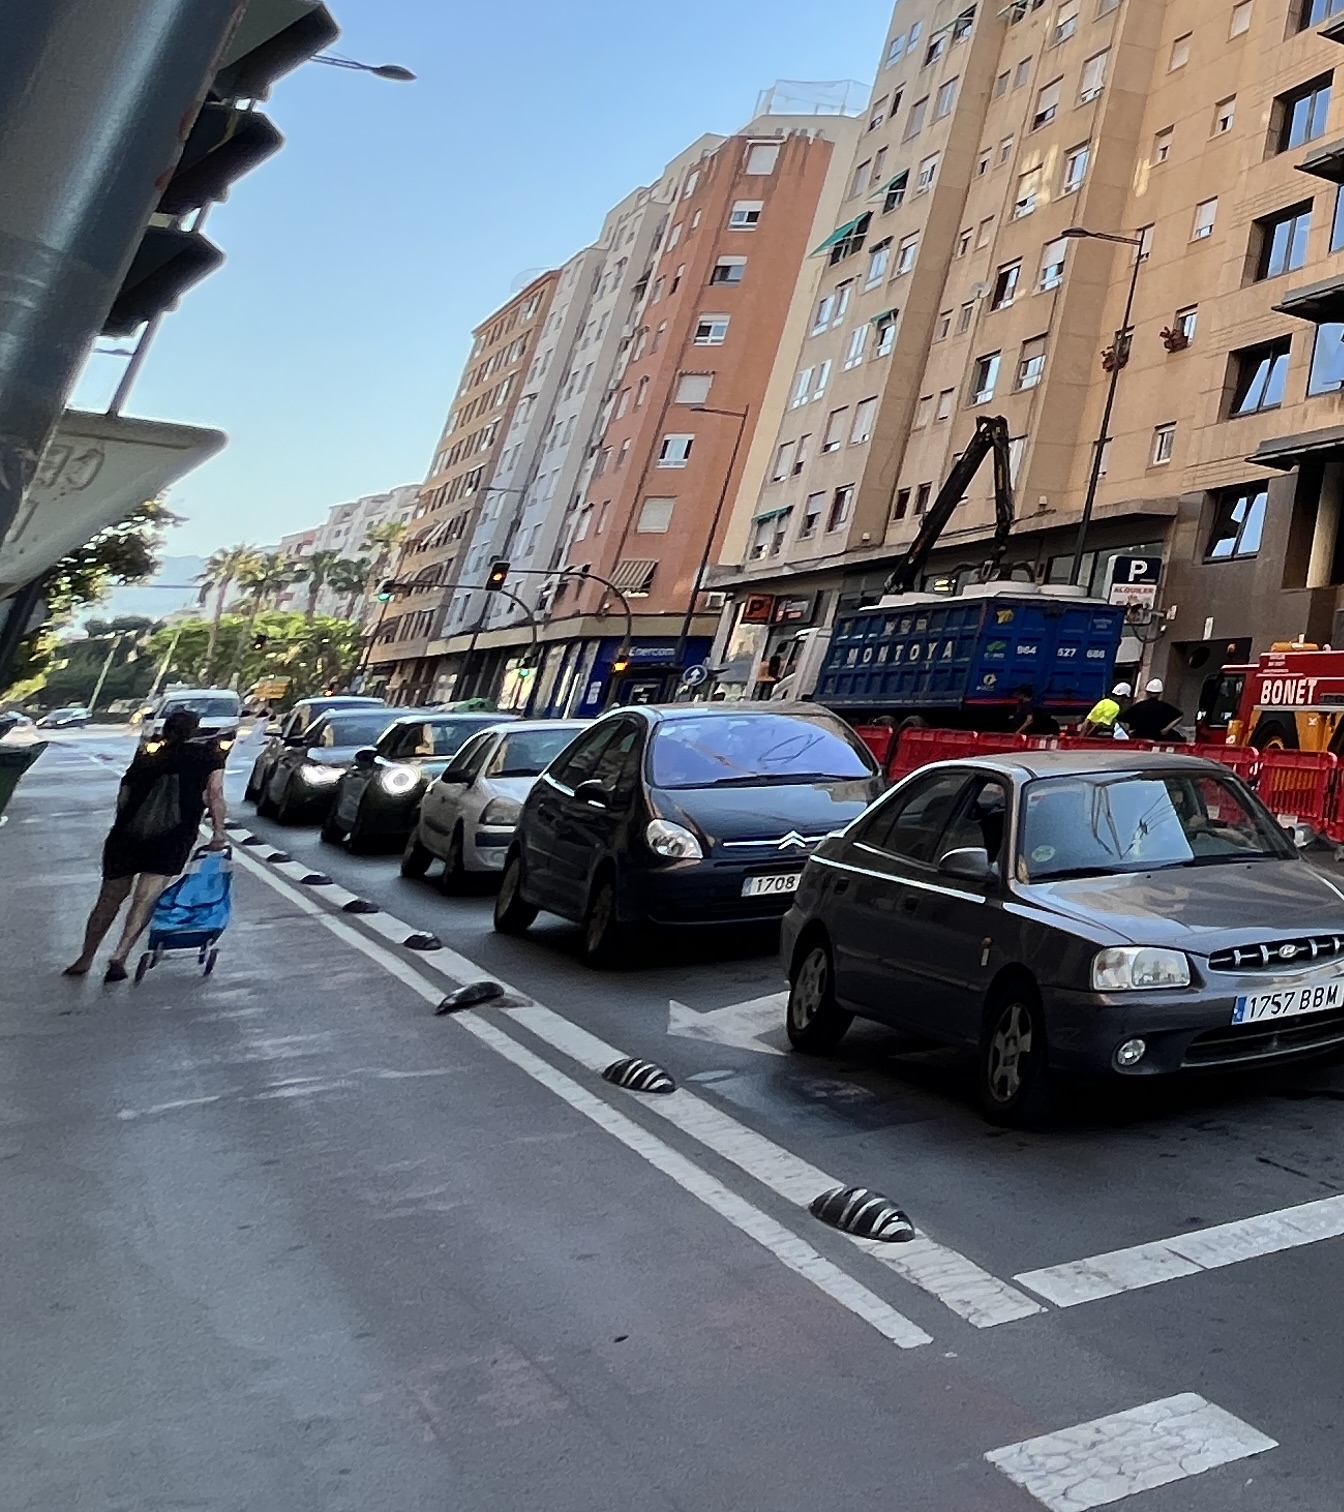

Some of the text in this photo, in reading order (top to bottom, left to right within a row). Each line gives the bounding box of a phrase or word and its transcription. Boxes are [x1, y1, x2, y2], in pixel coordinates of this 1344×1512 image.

[1128, 560, 1148, 581] P
[846, 640, 953, 664] MONTOYA
[1260, 679, 1318, 705] BONET
[756, 876, 796, 893] 1708
[1249, 985, 1339, 1019] 1757 BBM
